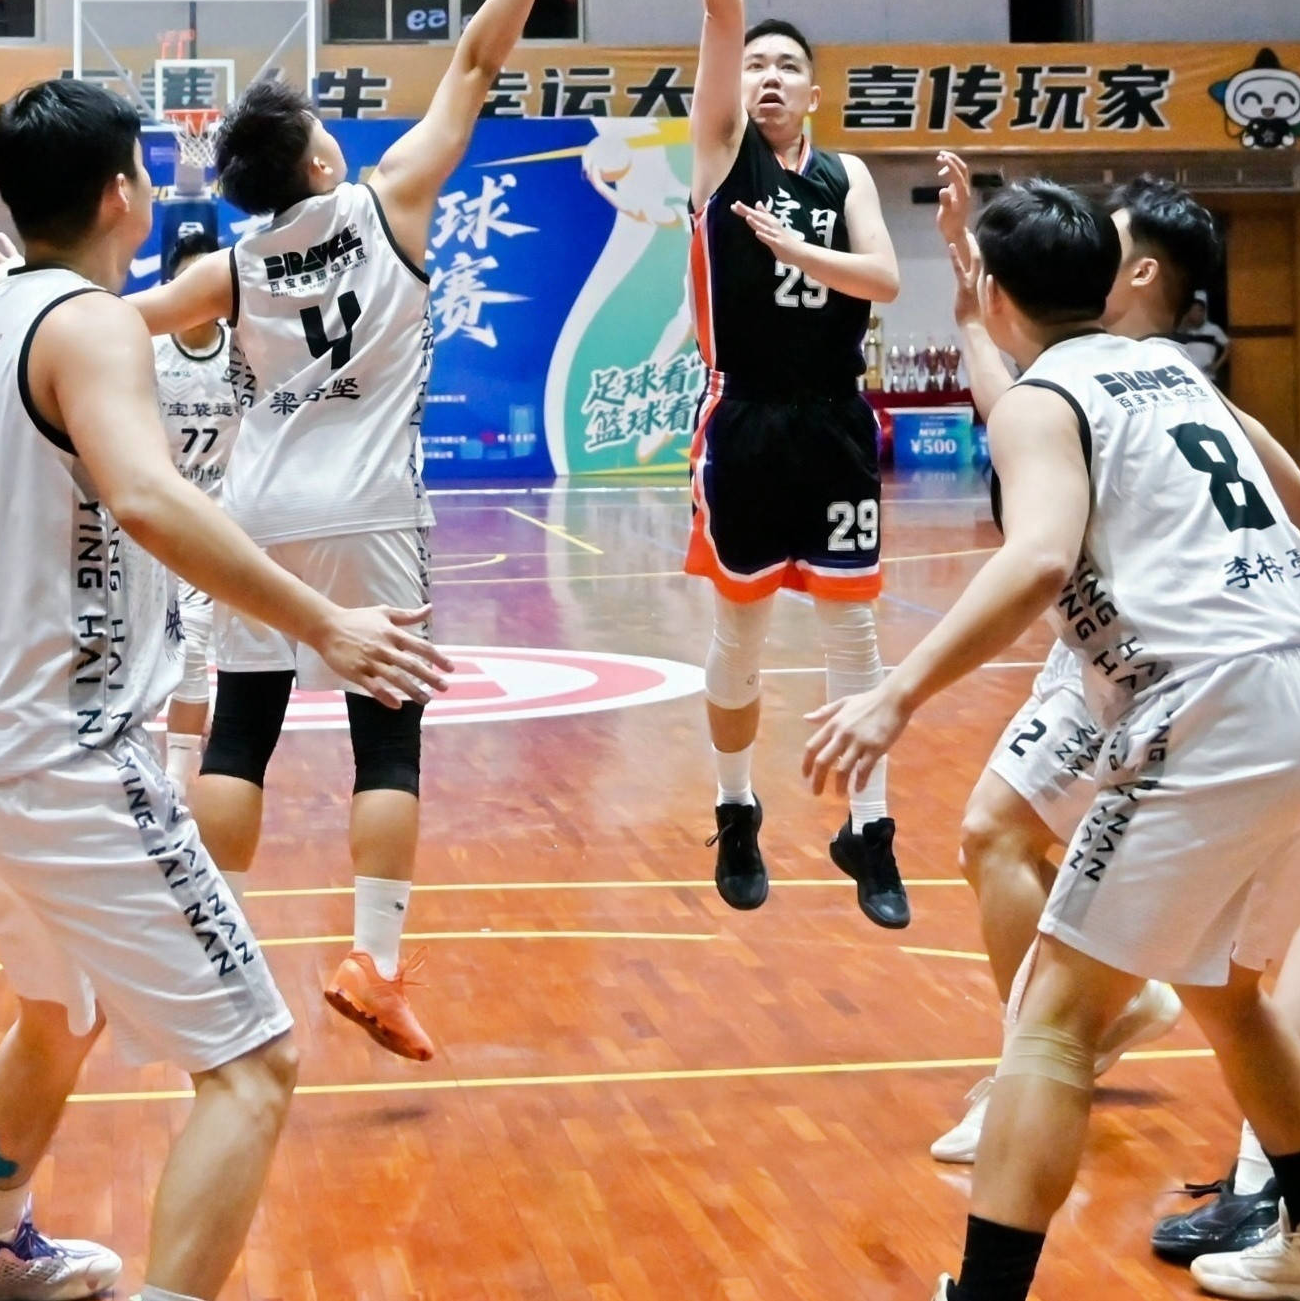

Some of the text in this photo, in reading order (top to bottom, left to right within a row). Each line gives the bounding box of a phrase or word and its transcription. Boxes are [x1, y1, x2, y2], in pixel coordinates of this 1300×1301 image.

[484, 66, 694, 118] 幸运大
[841, 64, 1175, 134] 喜传玩家
[432, 174, 540, 249] 球
[299, 290, 361, 369] 4
[162, 402, 241, 417] 宝袋运
[181, 428, 218, 453] 77
[1166, 422, 1276, 533] 8
[827, 499, 879, 551] 29
